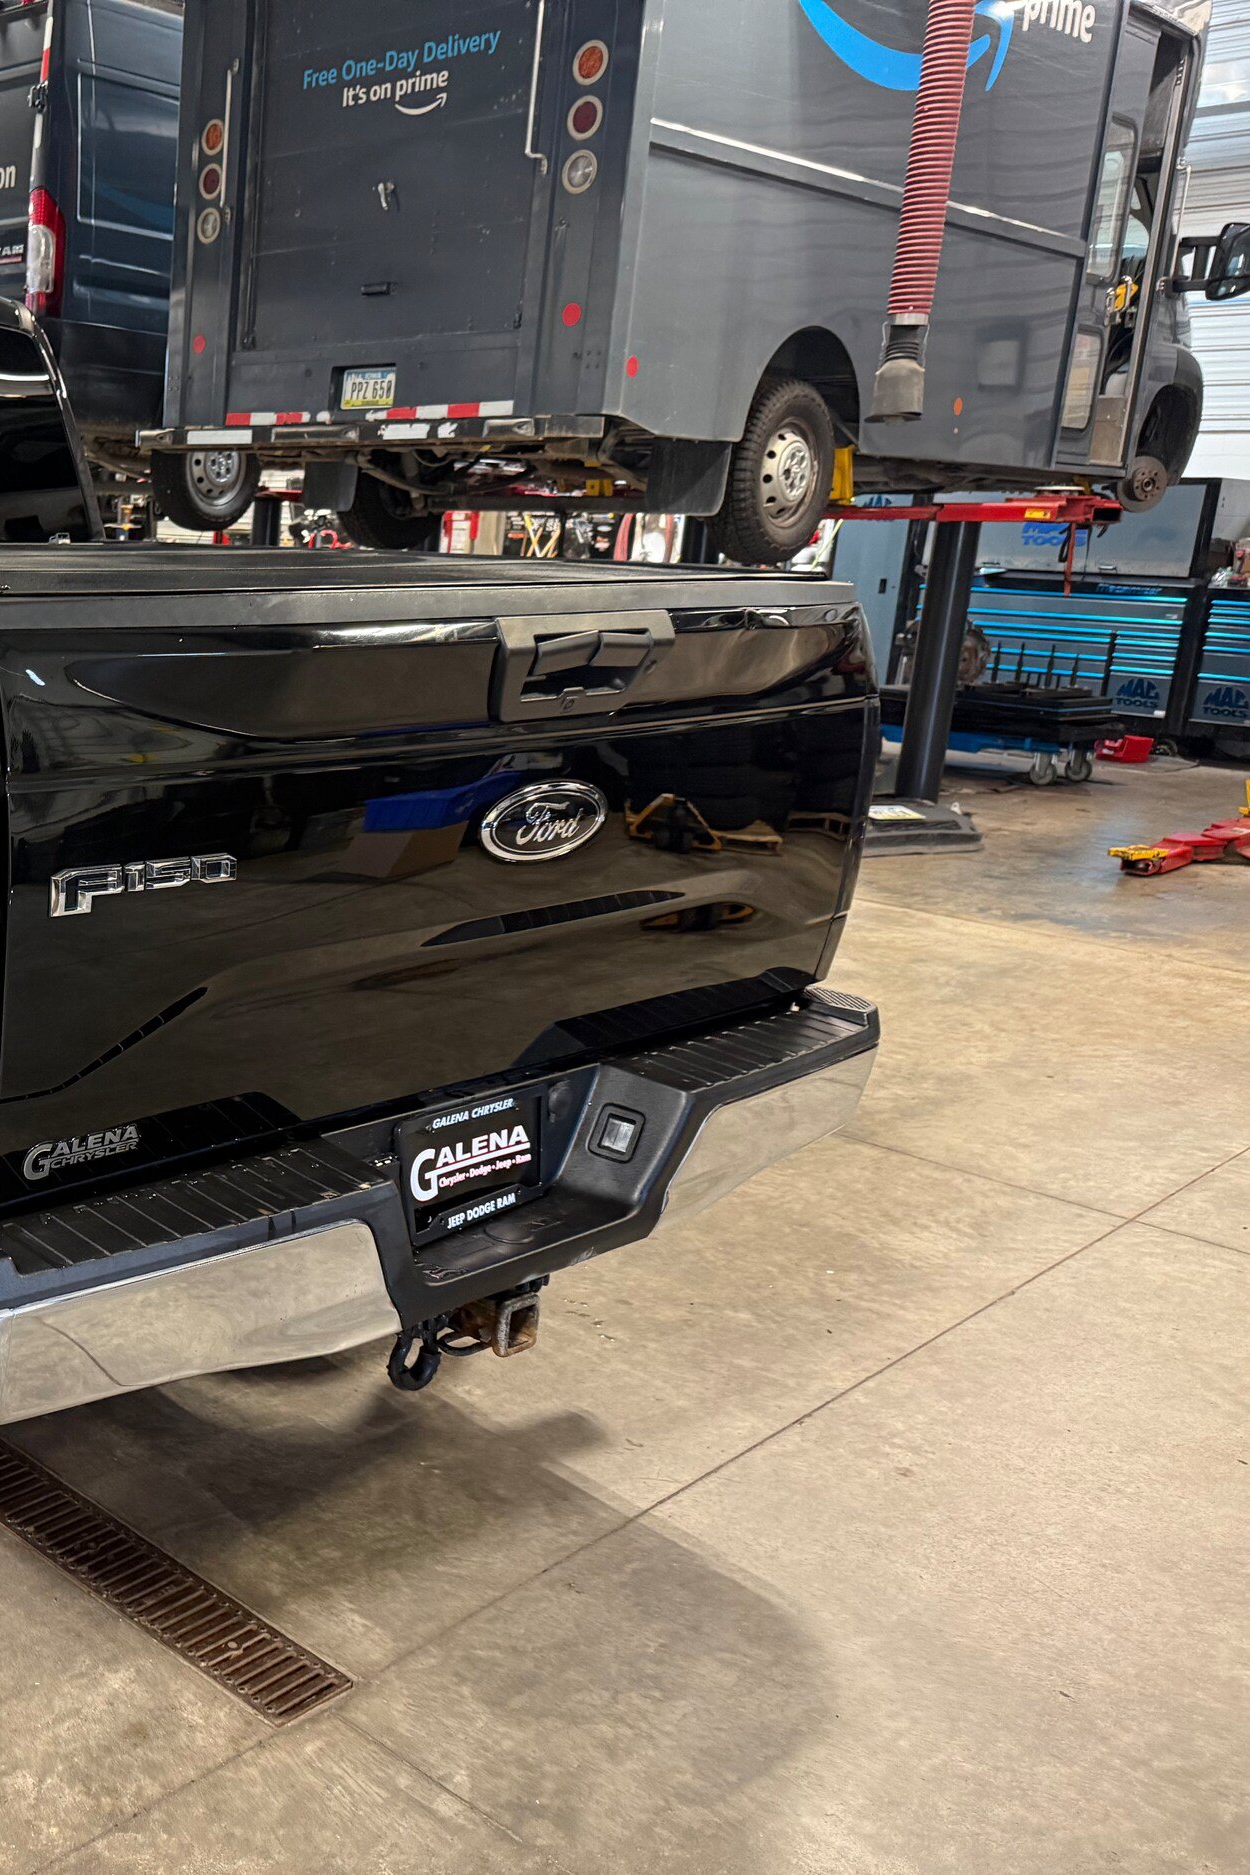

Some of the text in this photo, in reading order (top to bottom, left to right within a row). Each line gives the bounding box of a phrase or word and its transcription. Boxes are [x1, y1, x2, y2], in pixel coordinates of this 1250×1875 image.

[1022, 0, 1095, 43] prime
[303, 30, 501, 90] Free One-Day Delivery
[342, 70, 449, 107] It's on prime
[350, 380, 392, 400] PPZ 650
[1022, 535, 1088, 547] TOOS
[1116, 678, 1160, 700] MAC
[1116, 697, 1159, 709] TOOLS
[1203, 686, 1249, 709] MAC
[1203, 706, 1248, 717] TOOLS
[515, 801, 584, 845] Ford
[432, 1097, 514, 1129] GALENA CHRYSLER
[23, 1123, 139, 1180] GALENA
[50, 1141, 138, 1169] CHRYSLER
[410, 1125, 530, 1202] GALENA
[438, 1153, 532, 1188] Chrysler Dodge Jeep Ram
[447, 1192, 516, 1229] JEEP DODGE RAM
